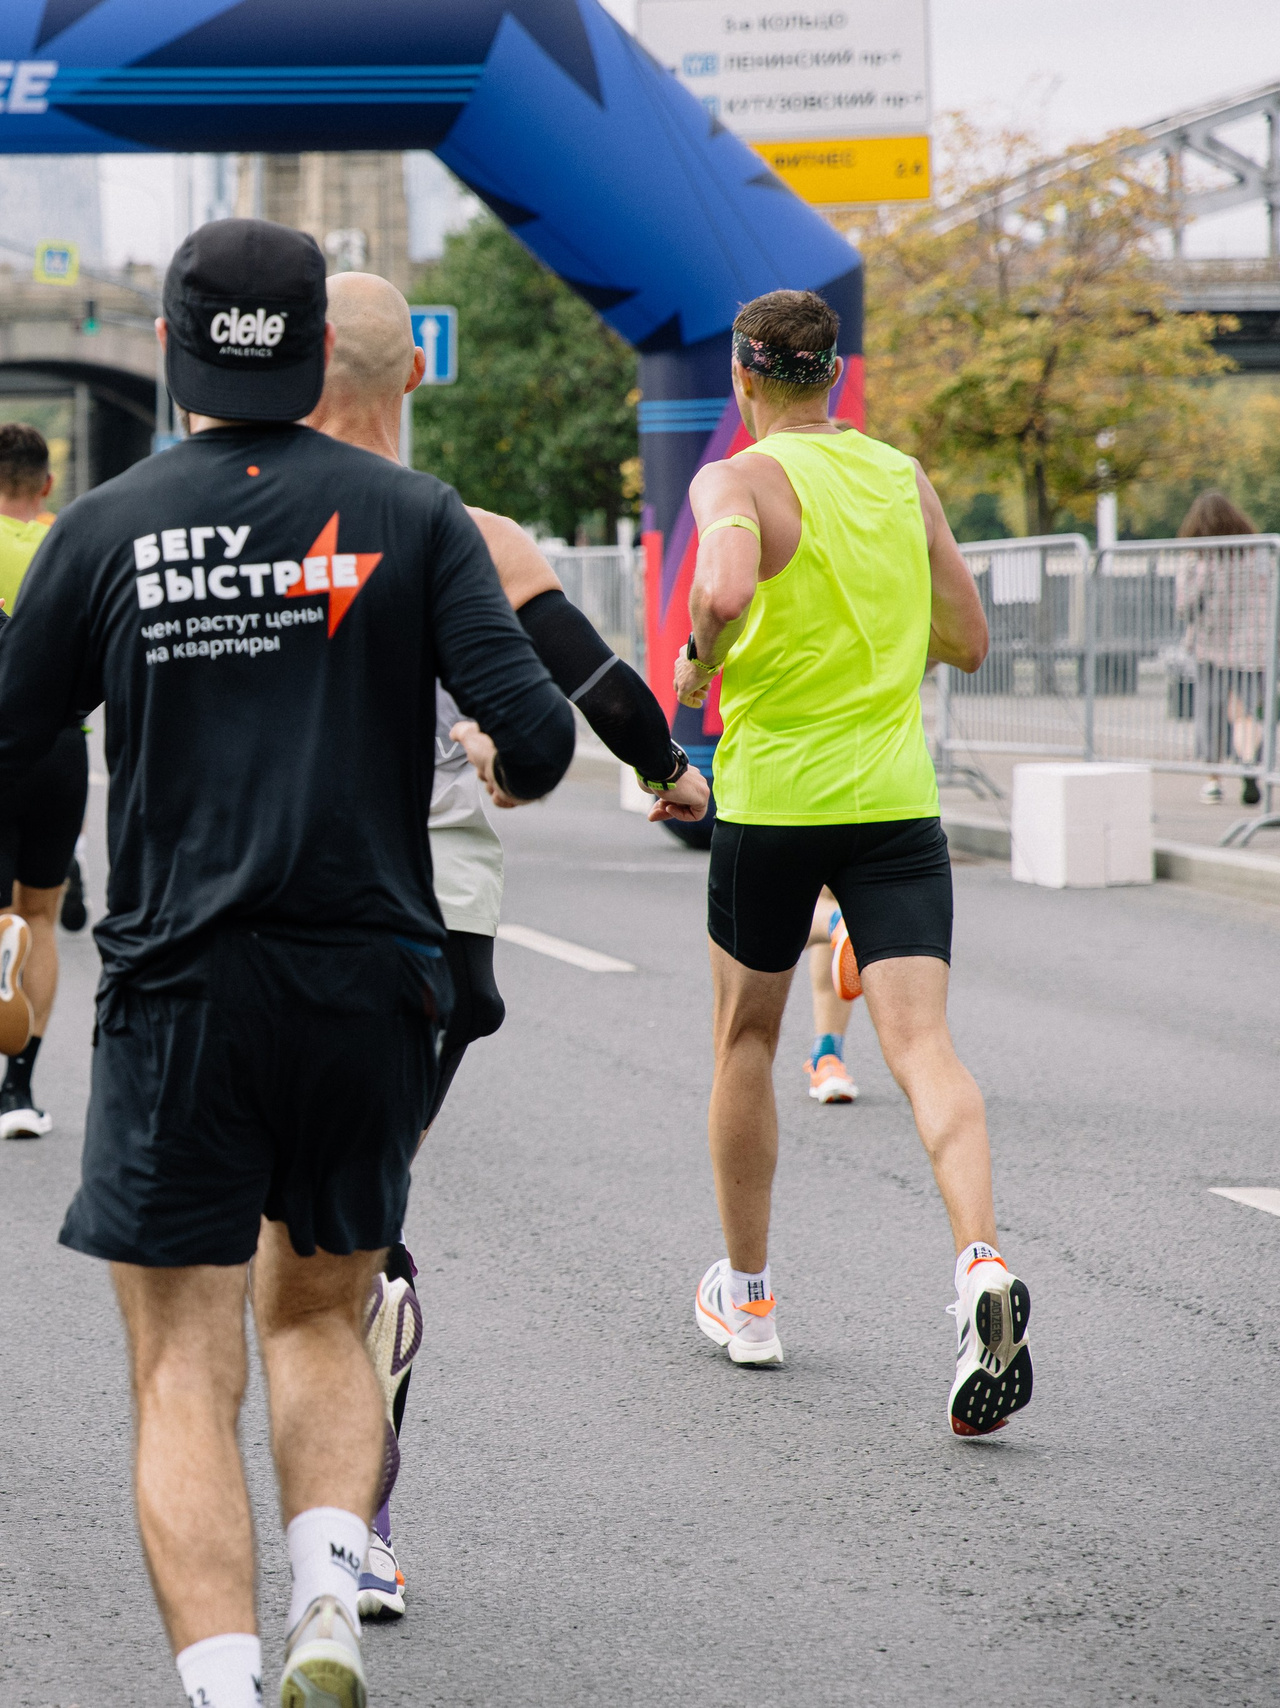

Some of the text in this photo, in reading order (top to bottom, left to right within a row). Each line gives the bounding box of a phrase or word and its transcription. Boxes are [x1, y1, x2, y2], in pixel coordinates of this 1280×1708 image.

[219, 346, 273, 357] ATHLETICS
[133, 525, 251, 571] БЕГУ
[135, 554, 358, 610] БЫСТРЕЕ
[141, 606, 324, 641] чем растут цены
[145, 635, 281, 665] на квартиры
[991, 1299, 1002, 1342] ADIZERO
